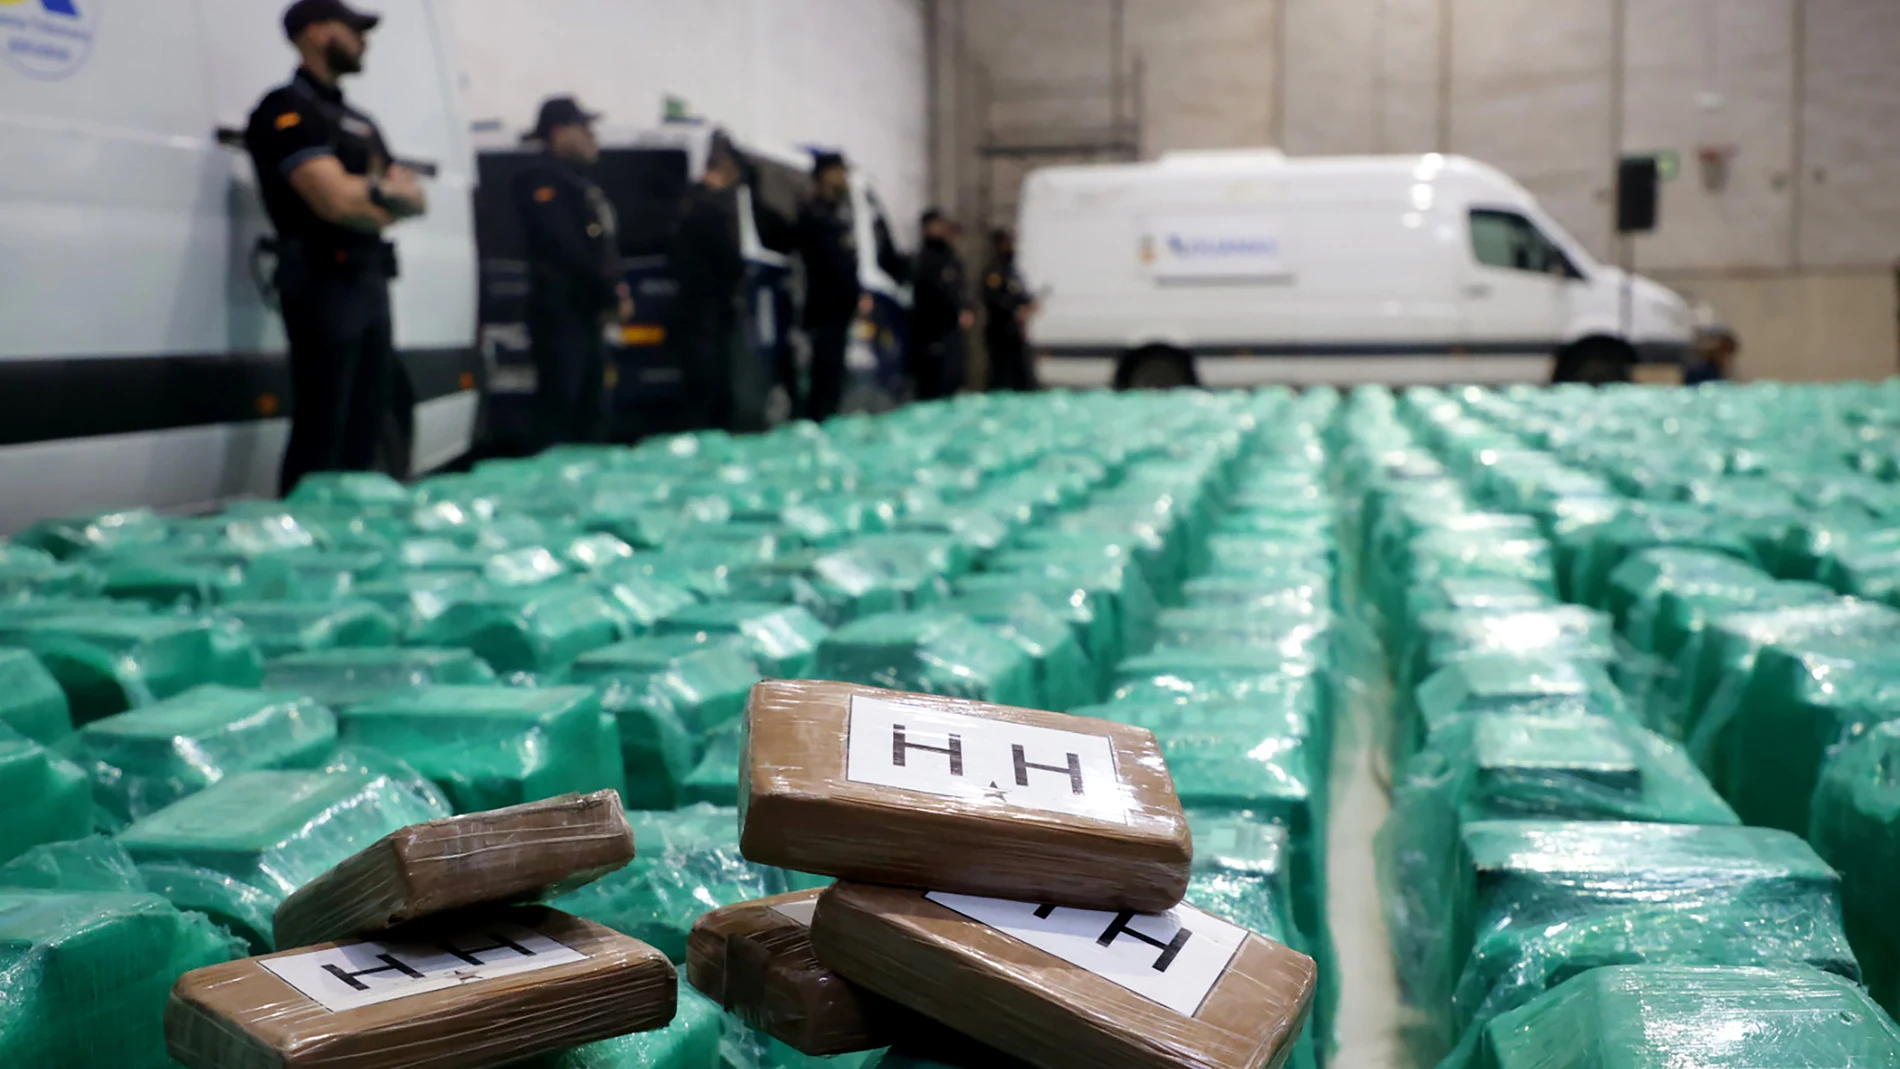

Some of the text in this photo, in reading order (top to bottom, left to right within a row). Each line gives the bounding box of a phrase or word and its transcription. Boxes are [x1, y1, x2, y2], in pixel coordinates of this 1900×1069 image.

[893, 724, 1084, 795] H H
[321, 931, 537, 991] H H
[1096, 911, 1193, 973] H
